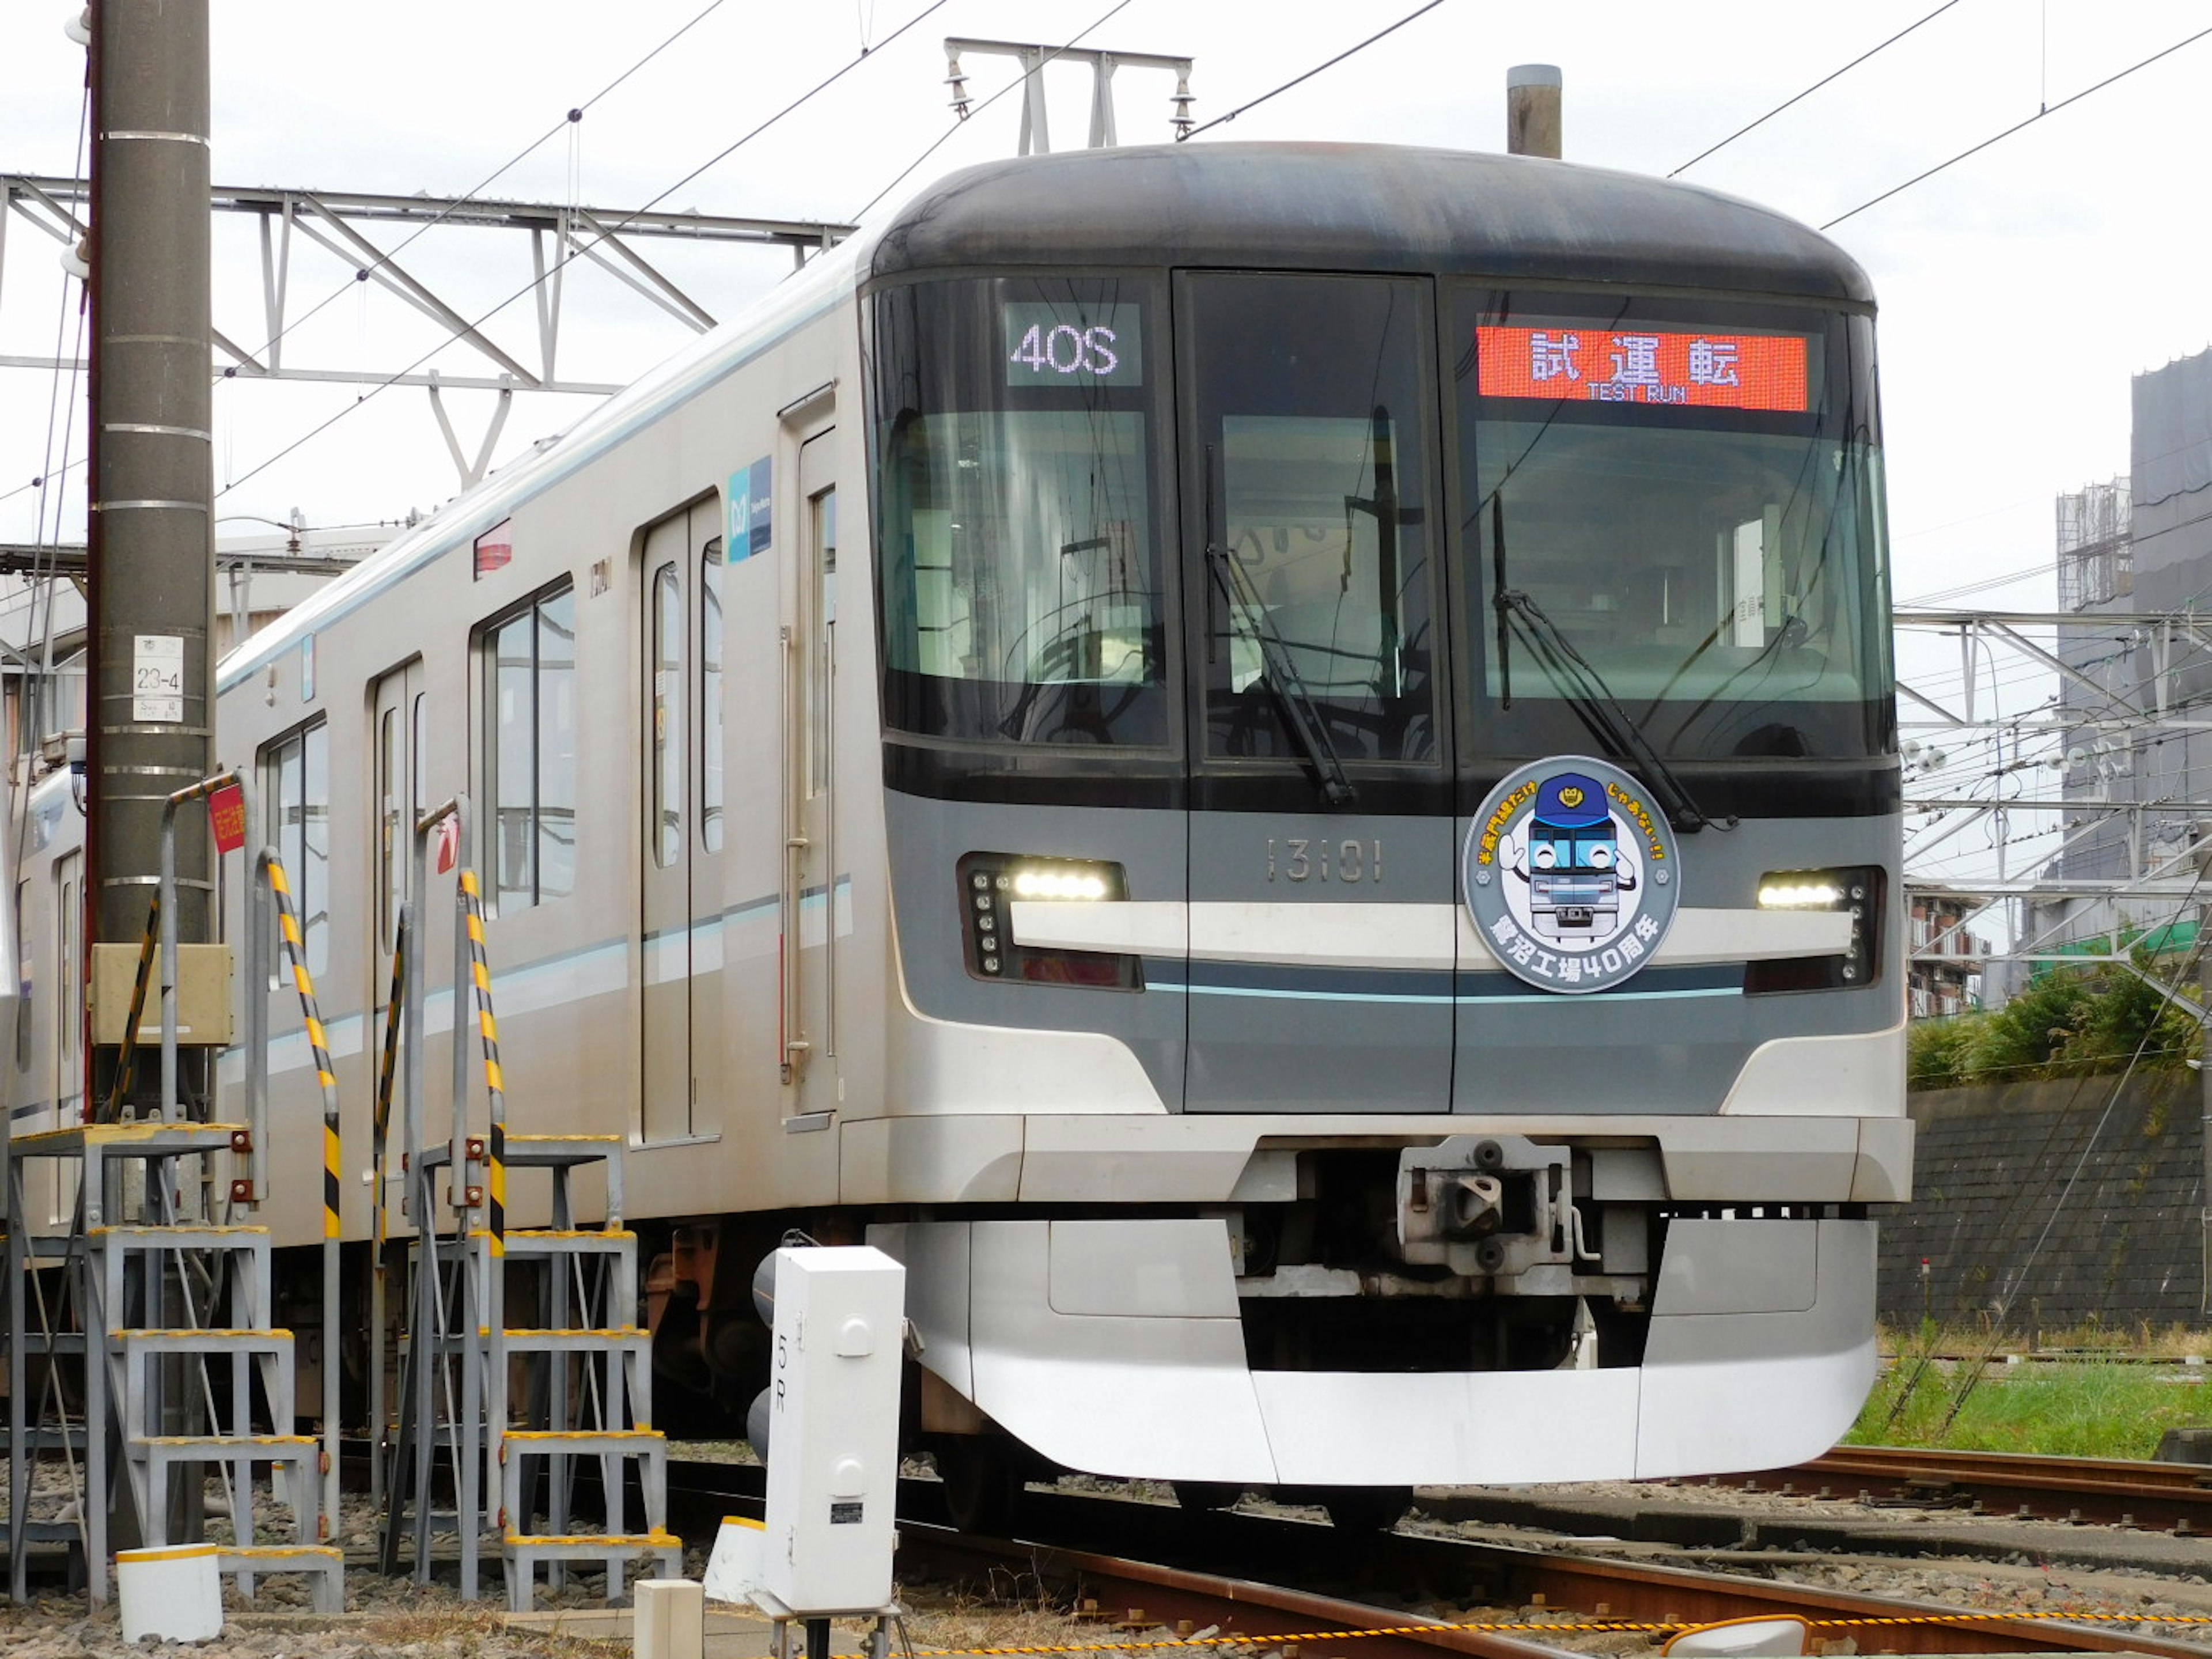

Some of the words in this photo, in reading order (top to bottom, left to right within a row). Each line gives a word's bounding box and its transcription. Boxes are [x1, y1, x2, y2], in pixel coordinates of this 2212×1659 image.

[1010, 324, 1118, 374] 40S
[1529, 332, 1738, 387] 試運転
[1587, 382, 1638, 402] TEST
[1645, 384, 1687, 403] RUN
[138, 668, 179, 690] 23-4
[1478, 780, 1537, 865] 半蔵門線だけ
[1267, 839, 1381, 882] 13101
[1490, 914, 1659, 982] 鷺沼工場40周年
